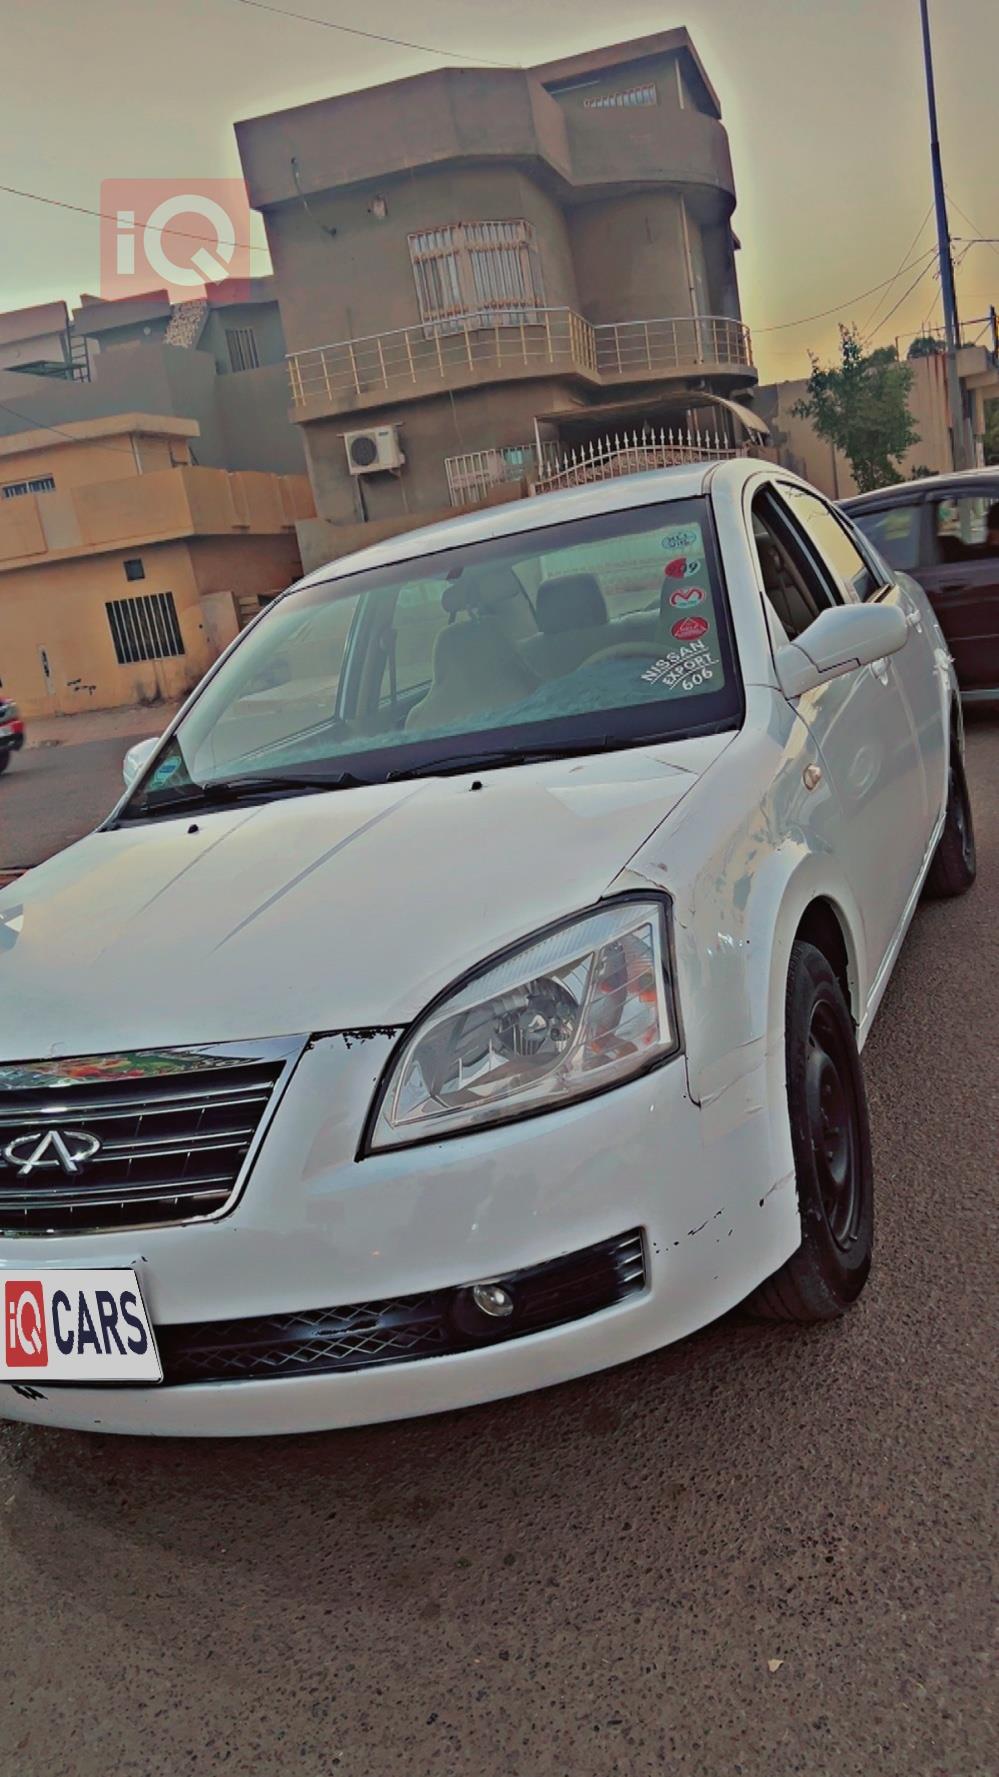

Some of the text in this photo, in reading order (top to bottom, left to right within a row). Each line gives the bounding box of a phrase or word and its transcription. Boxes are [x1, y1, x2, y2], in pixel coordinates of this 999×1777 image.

[641, 640, 705, 680] NISSAN
[662, 653, 712, 685] EXPORT
[682, 668, 713, 690] 606
